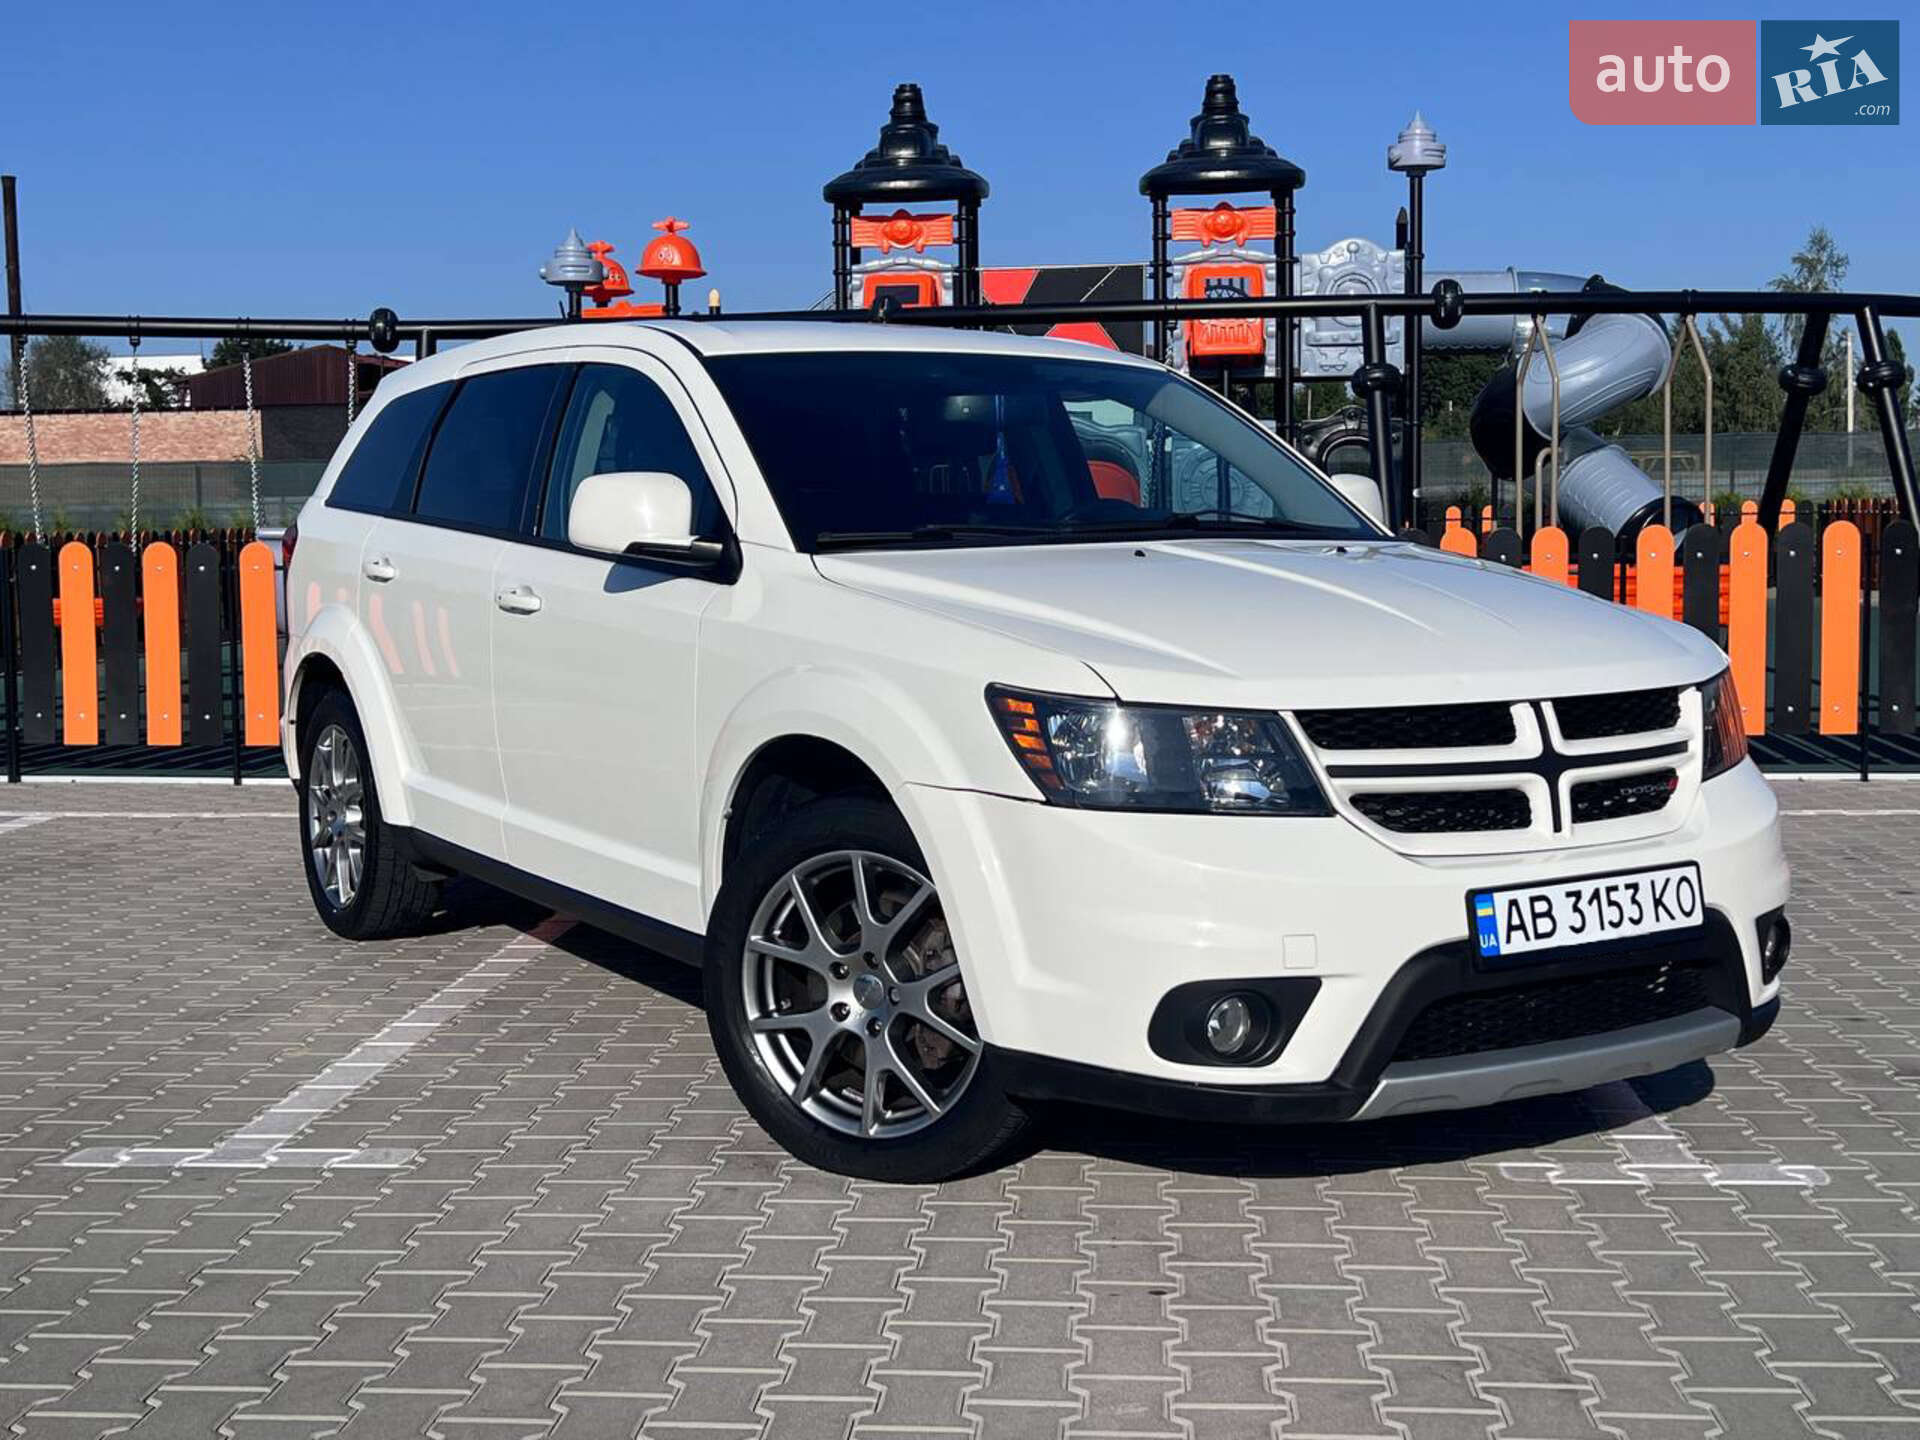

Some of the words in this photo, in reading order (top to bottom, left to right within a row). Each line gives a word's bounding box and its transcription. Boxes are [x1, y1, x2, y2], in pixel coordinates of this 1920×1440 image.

[1505, 894, 1557, 945] AB
[1565, 881, 1644, 934] 3153
[1650, 874, 1697, 923] KO
[1479, 933, 1498, 948] UA
